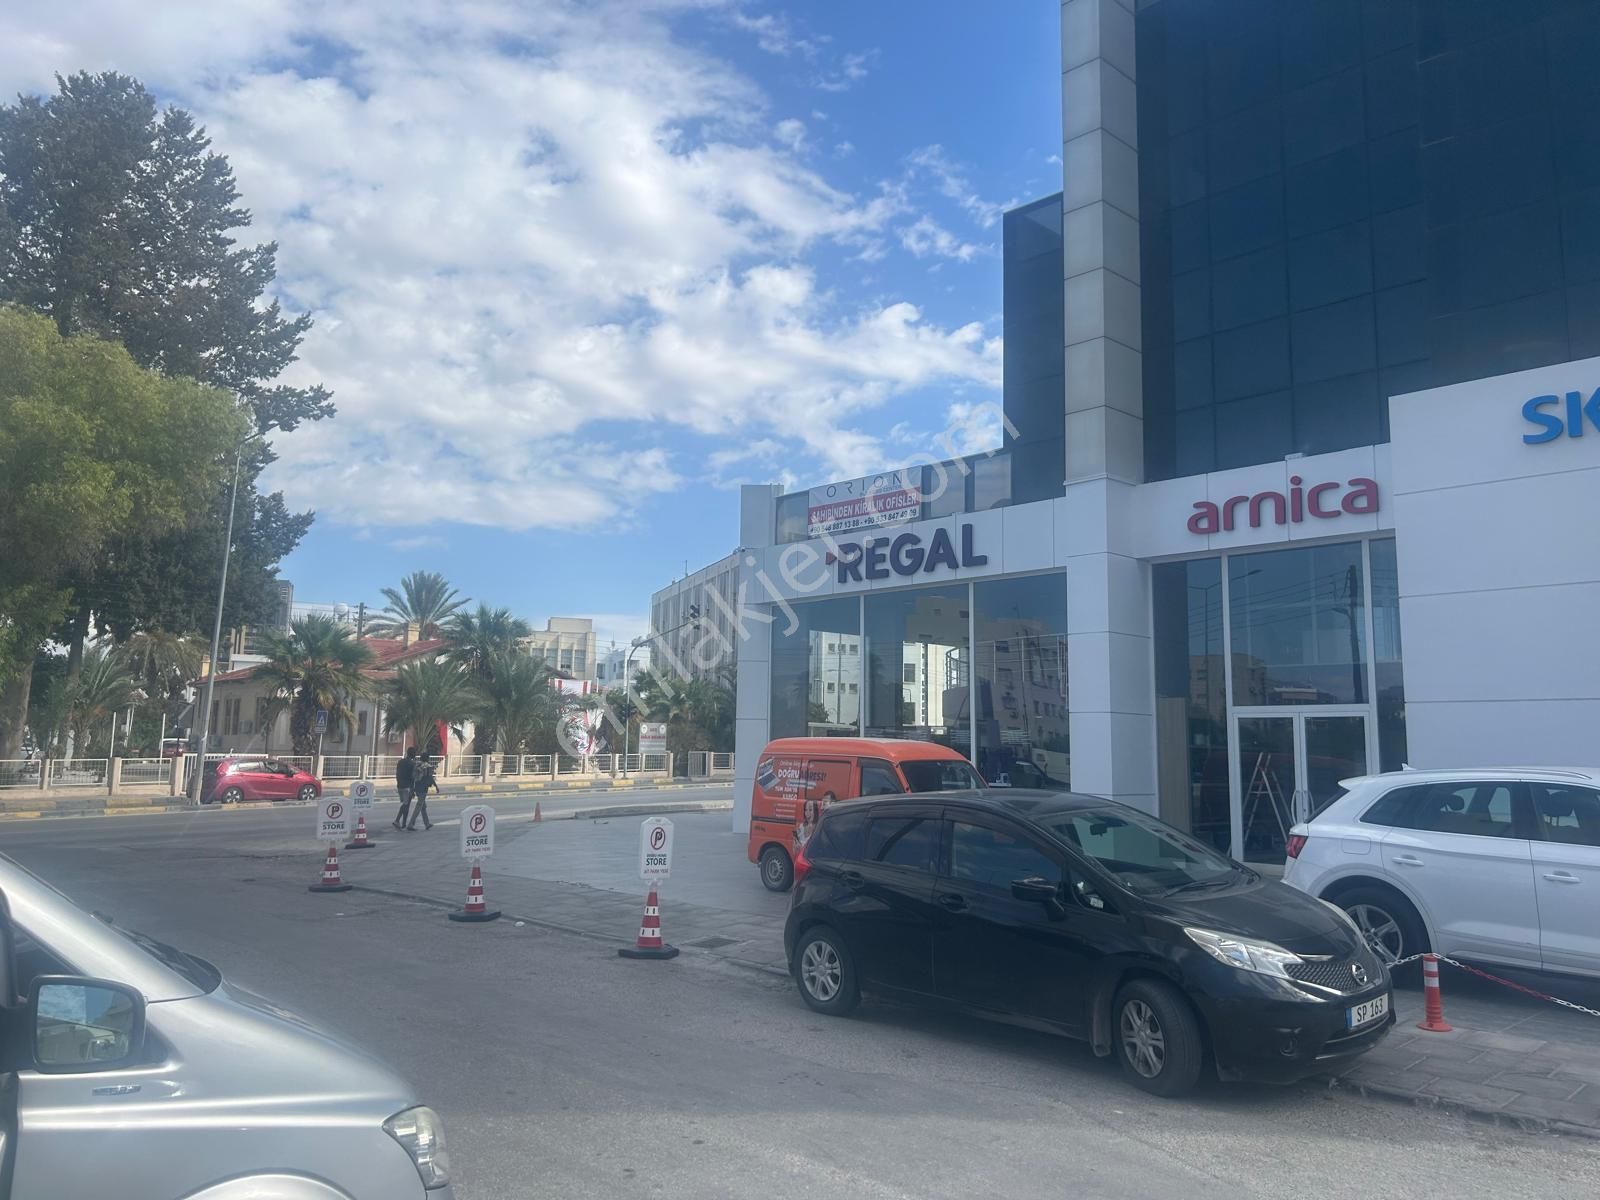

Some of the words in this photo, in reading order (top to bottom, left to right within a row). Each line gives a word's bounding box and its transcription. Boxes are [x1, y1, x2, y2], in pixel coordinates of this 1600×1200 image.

[826, 471, 904, 498] ORION
[1186, 475, 1380, 535] arnica
[837, 523, 988, 584] REGAL
[322, 823, 345, 831] STORE
[466, 838, 489, 847] STORE
[645, 857, 667, 866] STORE
[1356, 1004, 1368, 1023] SP
[1370, 998, 1383, 1018] 163
